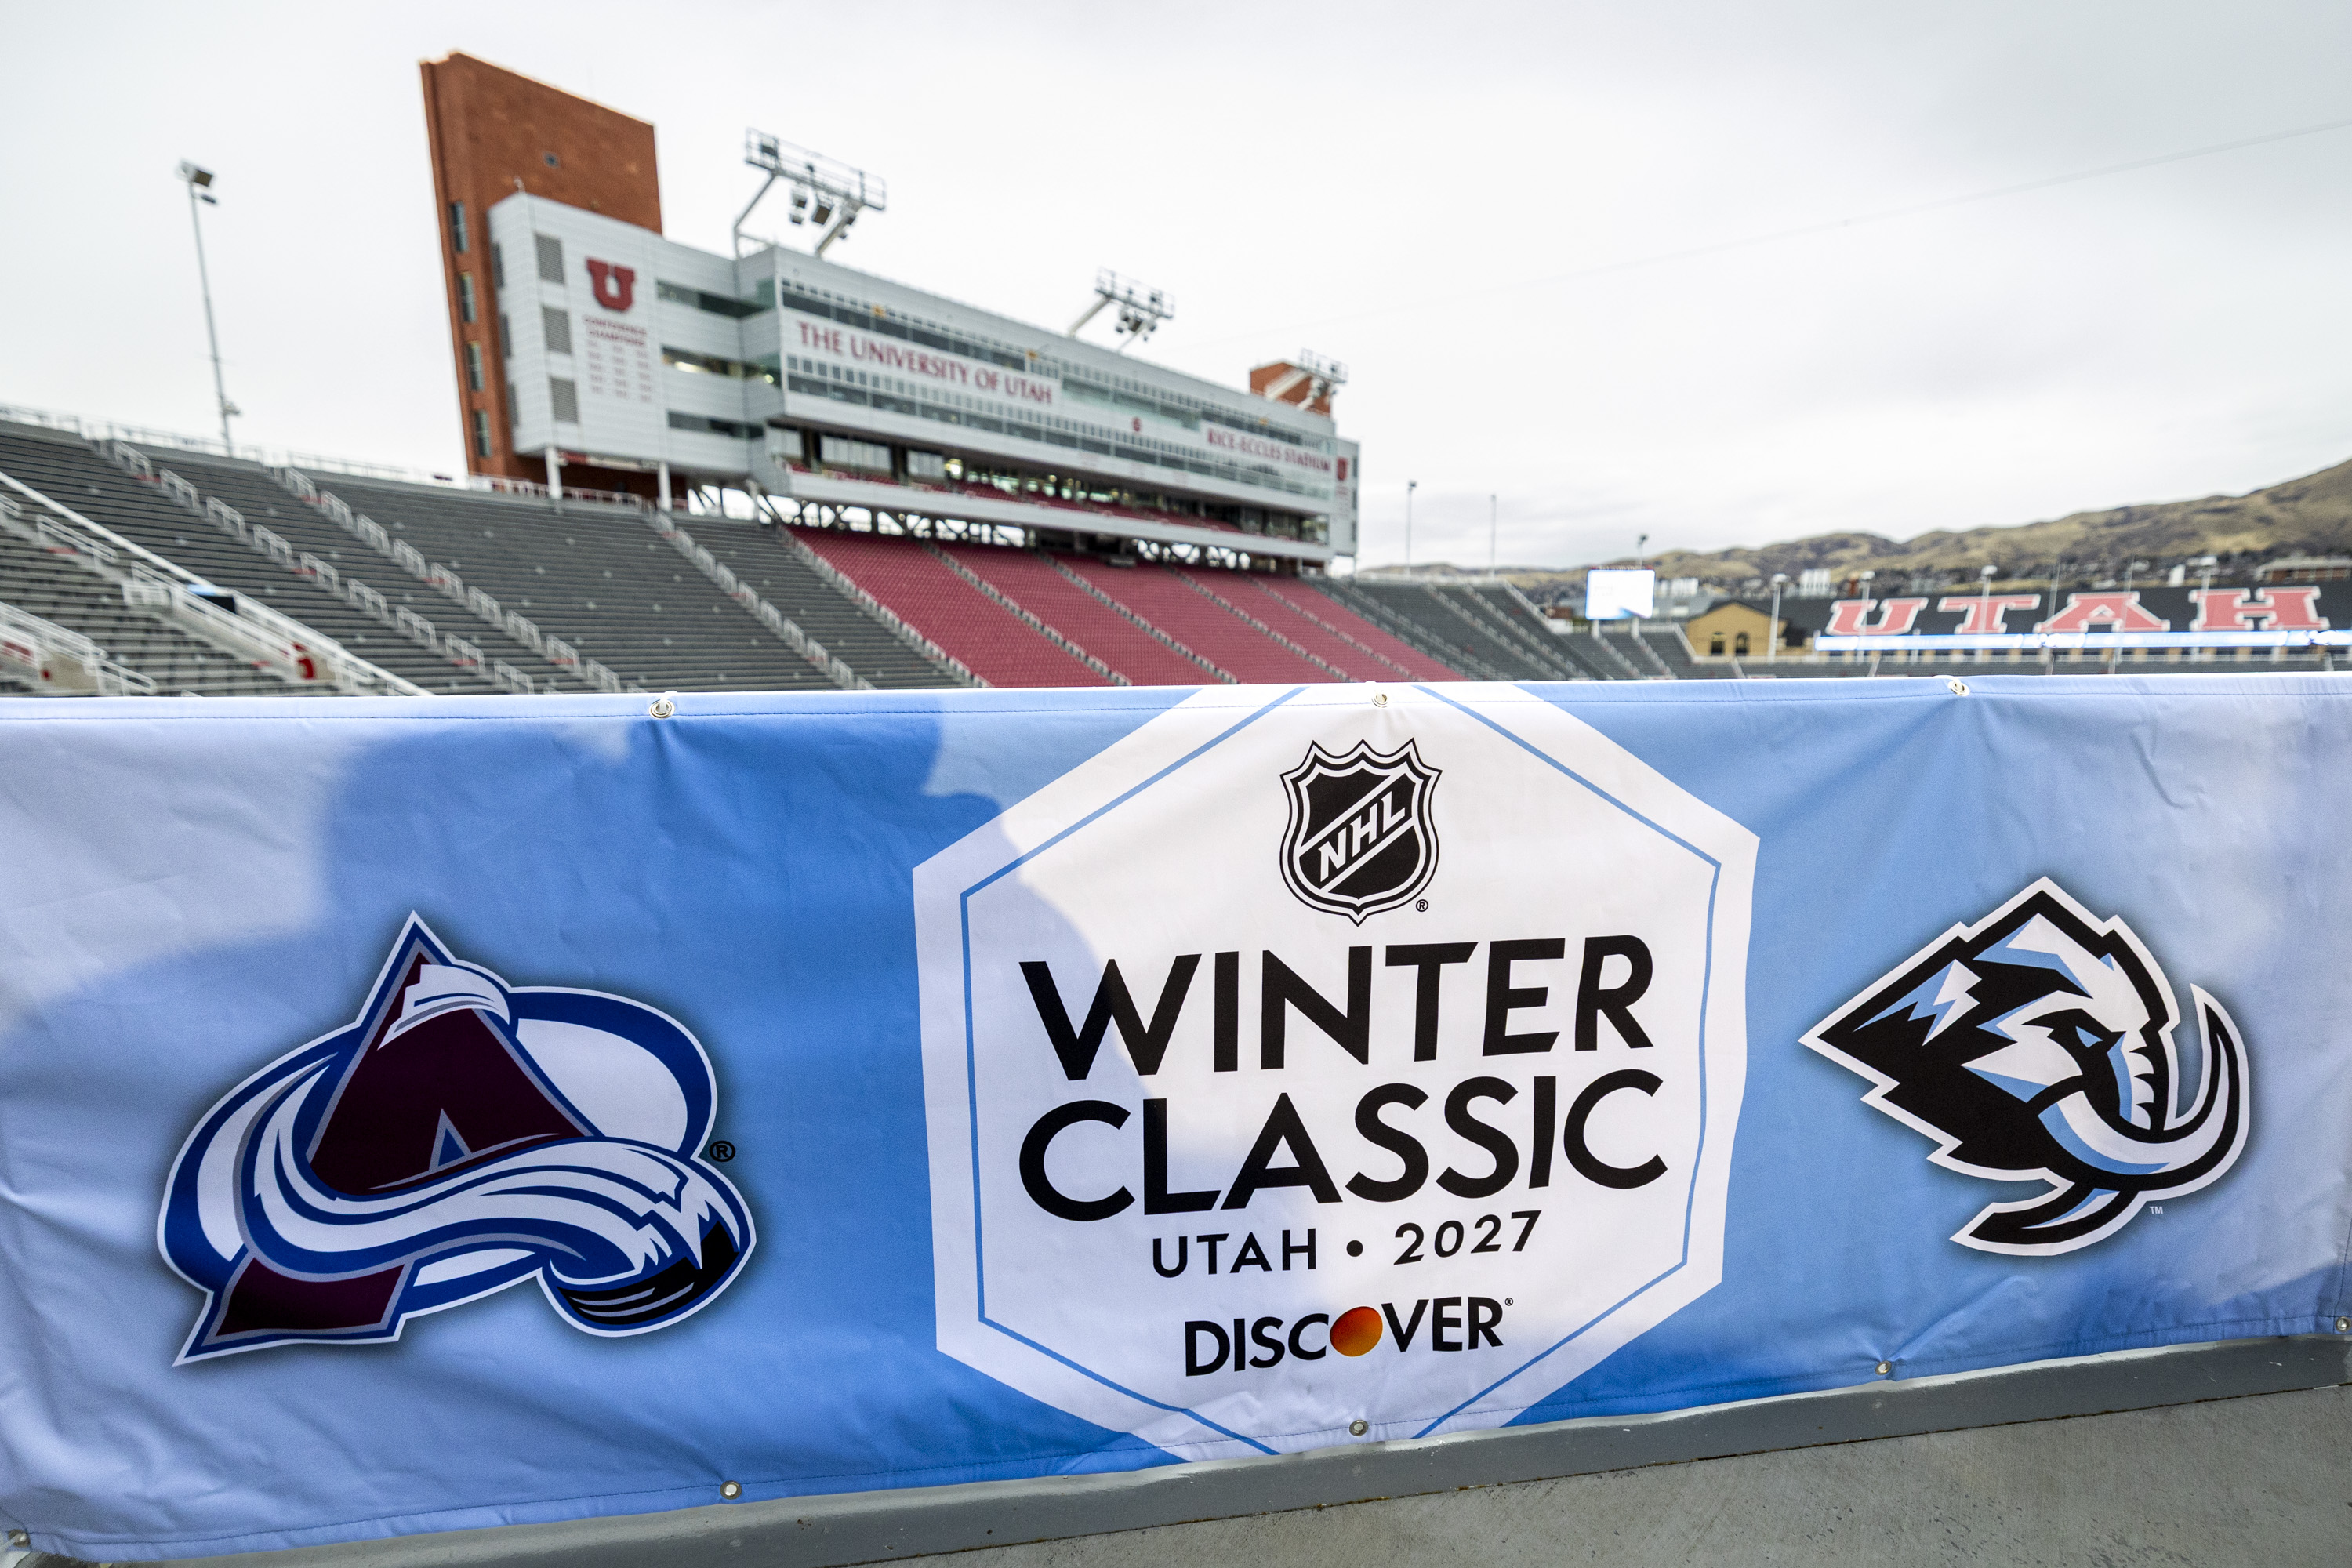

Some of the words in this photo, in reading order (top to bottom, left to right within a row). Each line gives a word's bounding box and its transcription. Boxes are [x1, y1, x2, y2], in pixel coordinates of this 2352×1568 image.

[586, 256, 637, 311] U
[797, 320, 840, 352] THE
[849, 335, 967, 383] UNIVERSITY
[975, 368, 998, 390] OF
[1004, 377, 1053, 405] UTAH
[1825, 586, 2330, 636] UTAH
[1318, 790, 1406, 883] NHL
[1018, 934, 1654, 1080] WINTER
[1018, 1069, 1668, 1221] CLASSIC
[1152, 1228, 1316, 1278] UTAH
[1393, 1210, 1542, 1265] 2027
[1185, 1296, 1504, 1377] DISCOVER
